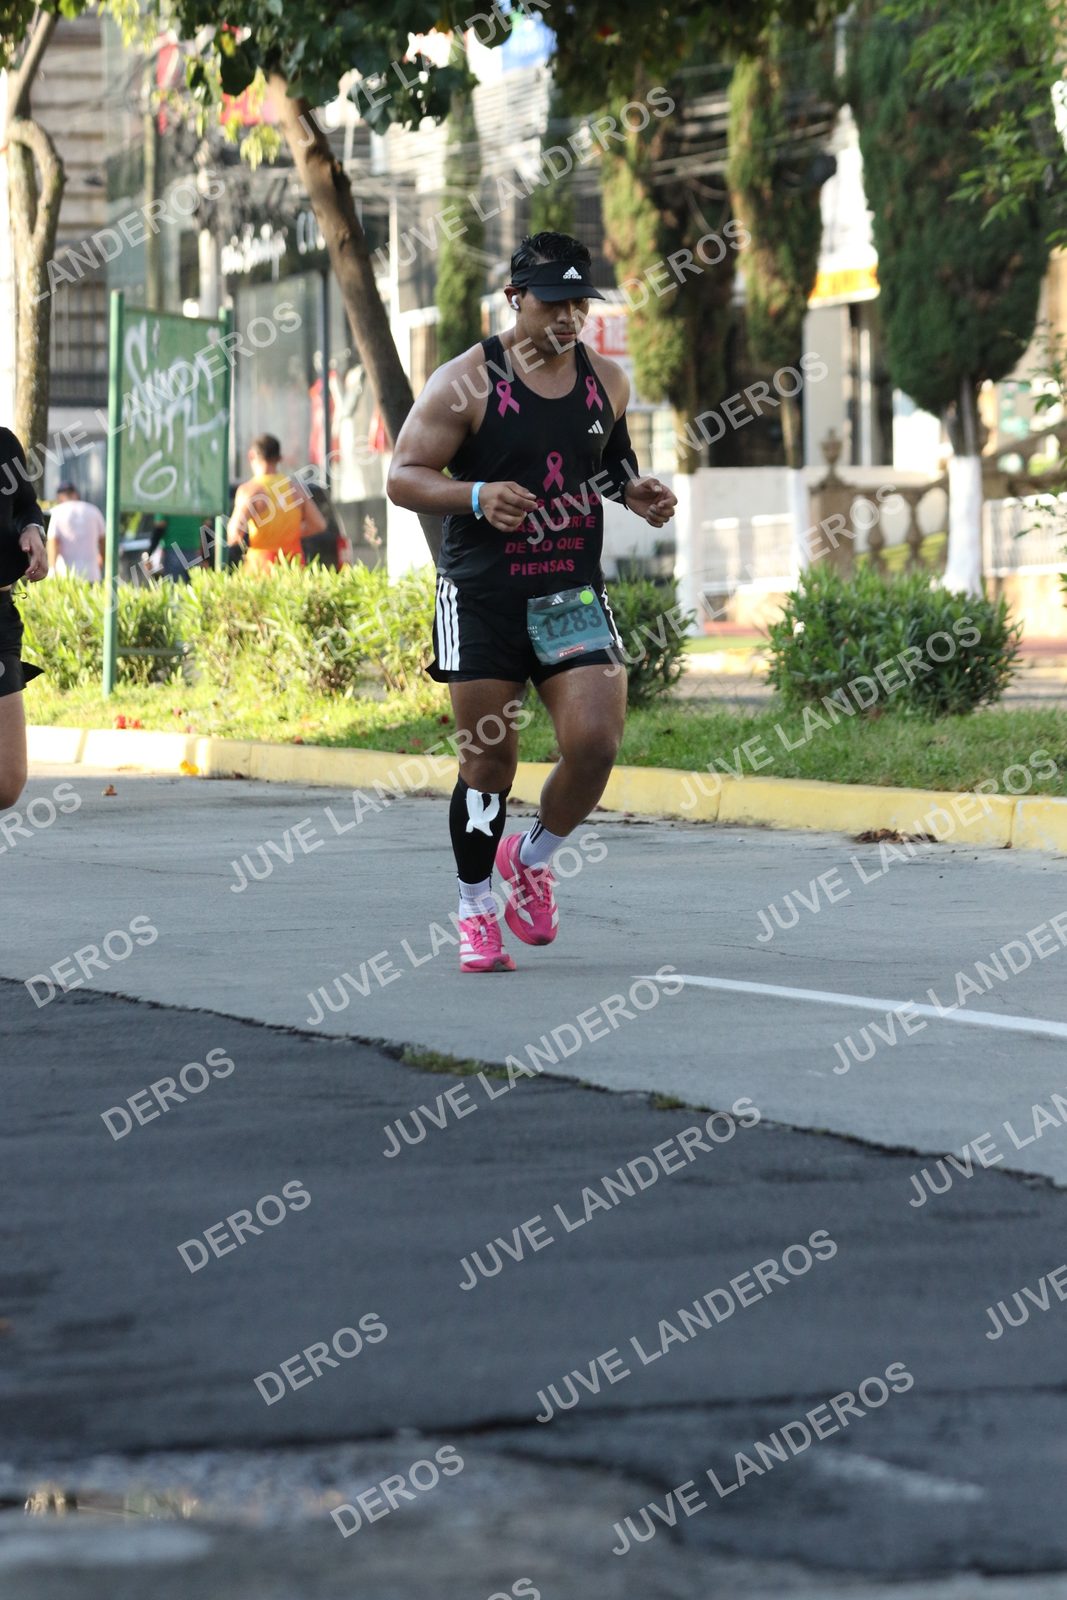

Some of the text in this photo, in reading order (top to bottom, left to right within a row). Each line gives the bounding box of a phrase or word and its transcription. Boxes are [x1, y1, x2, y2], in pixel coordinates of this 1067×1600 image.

[504, 536, 586, 555] DE LO QUE
[509, 558, 576, 577] PIENSAS
[541, 605, 603, 641] 1283
